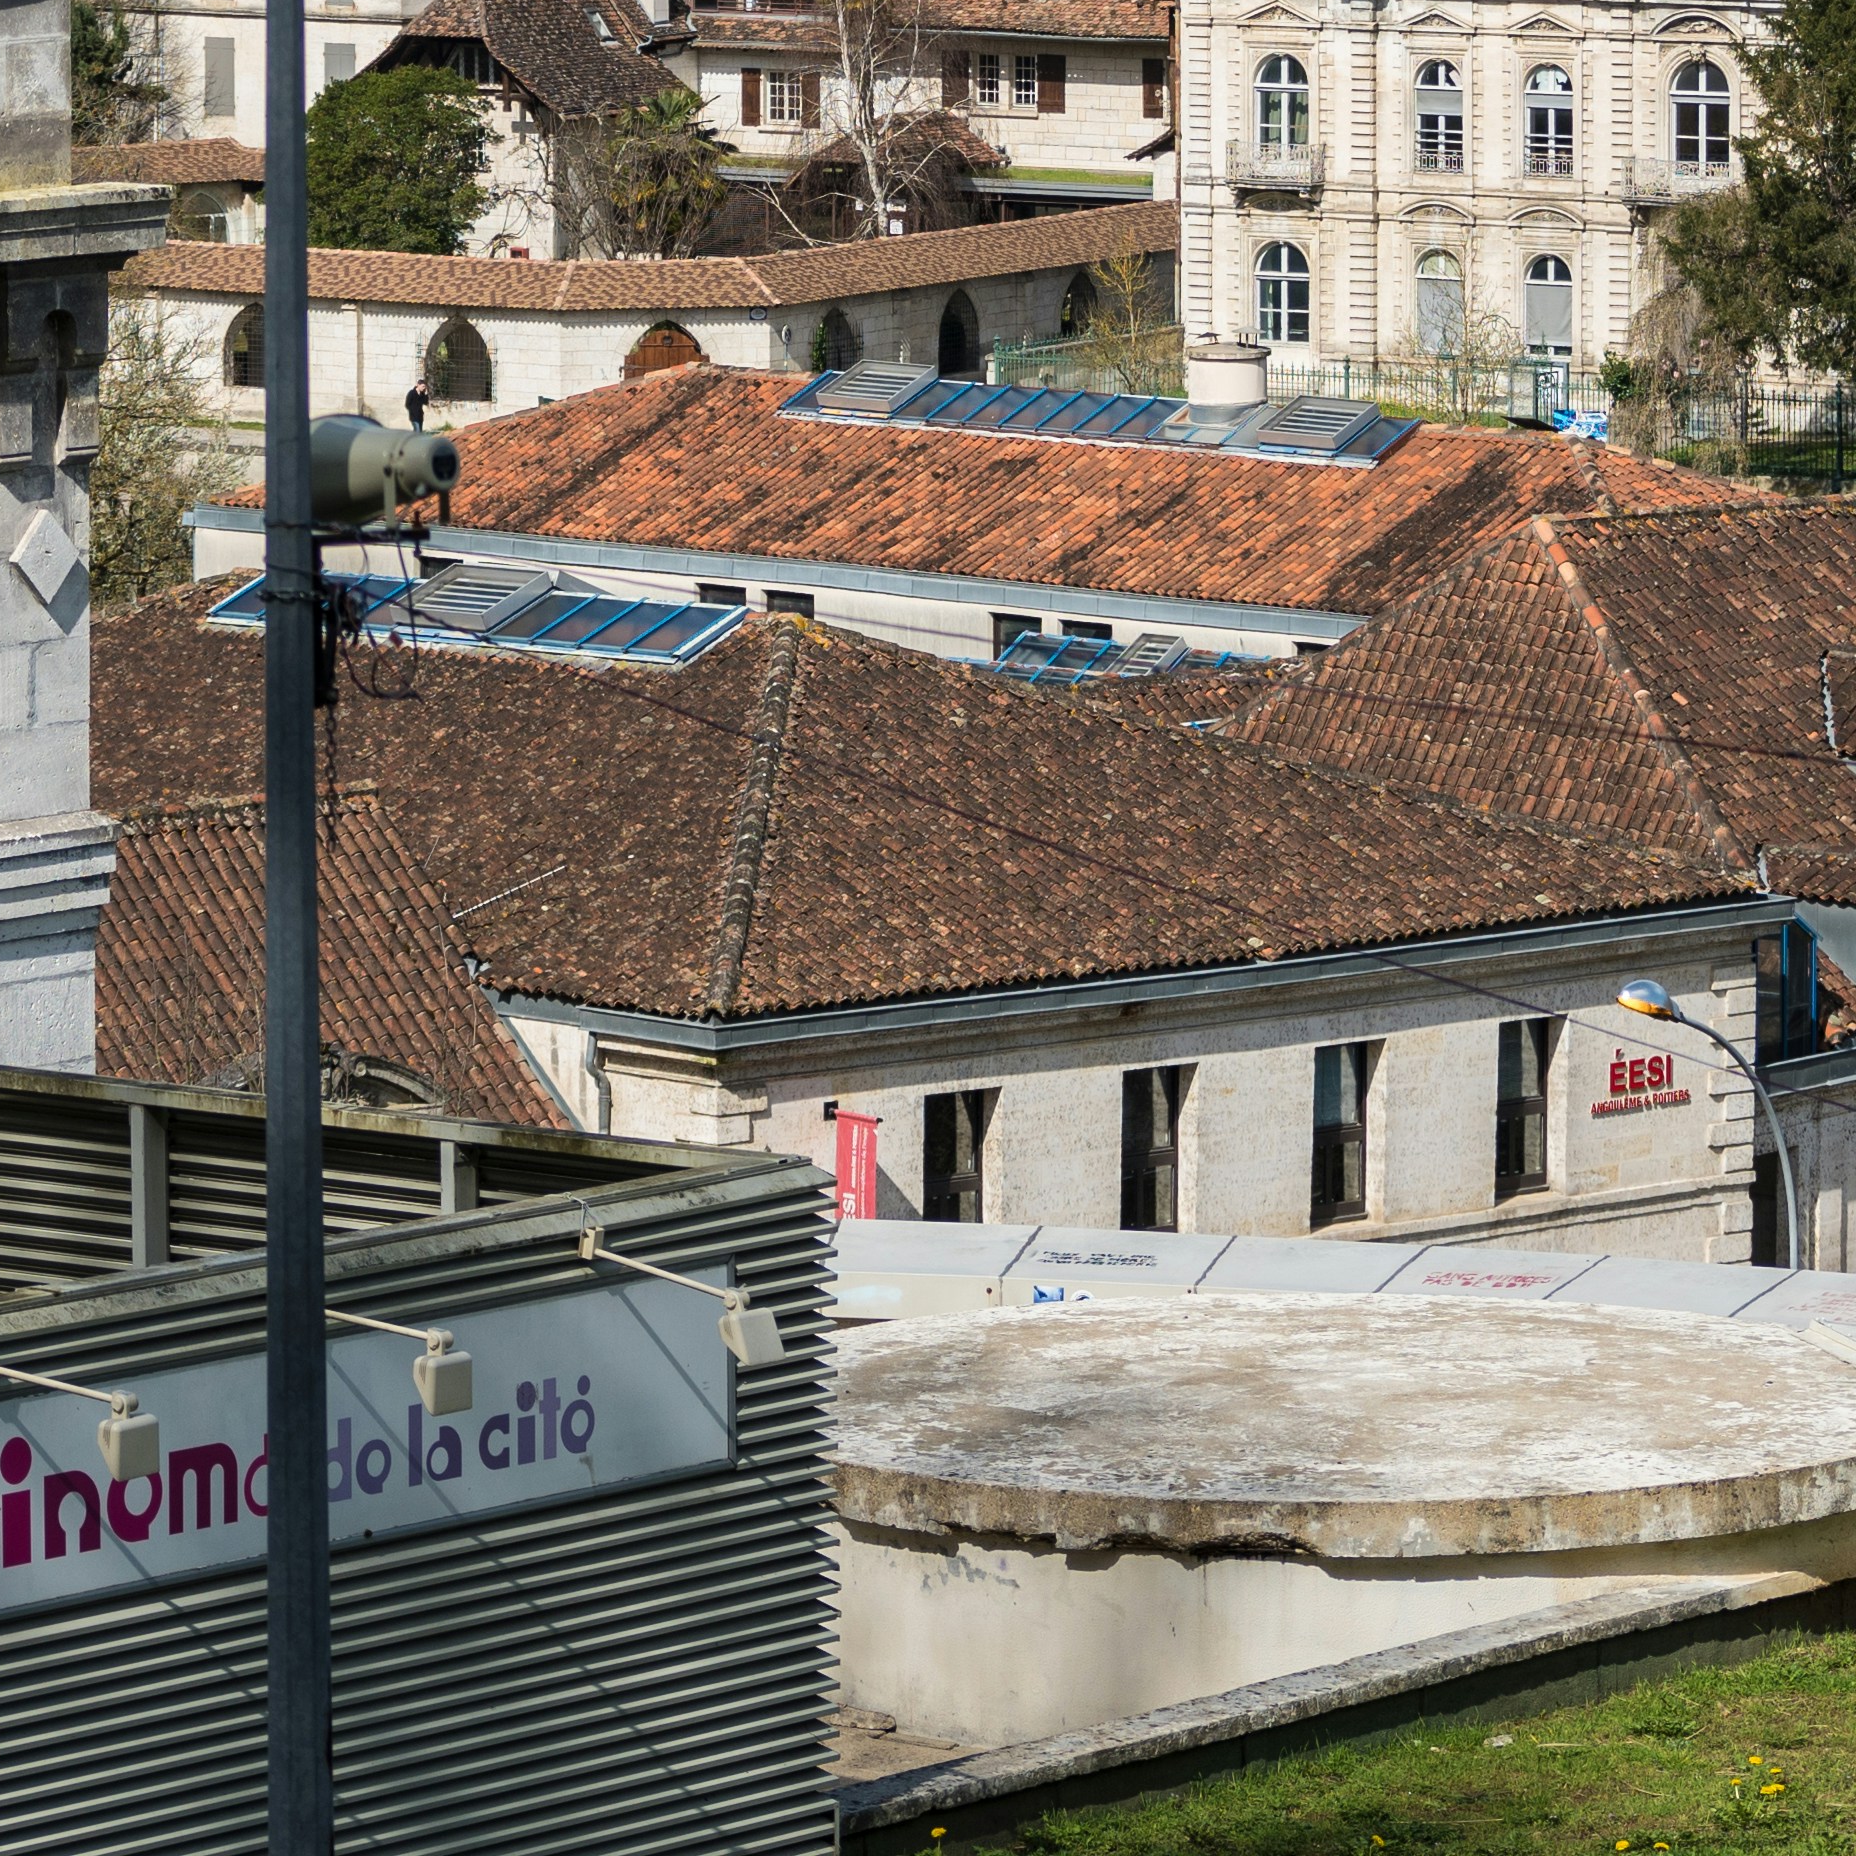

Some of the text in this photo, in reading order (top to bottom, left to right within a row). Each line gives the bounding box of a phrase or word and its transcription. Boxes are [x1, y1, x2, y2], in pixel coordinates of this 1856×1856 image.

[1609, 1047, 1672, 1093] ÉESI
[1643, 1095, 1651, 1107] &
[1652, 1089, 1690, 1105] POITIERS
[407, 1402, 462, 1489] la
[478, 1373, 597, 1472] cité
